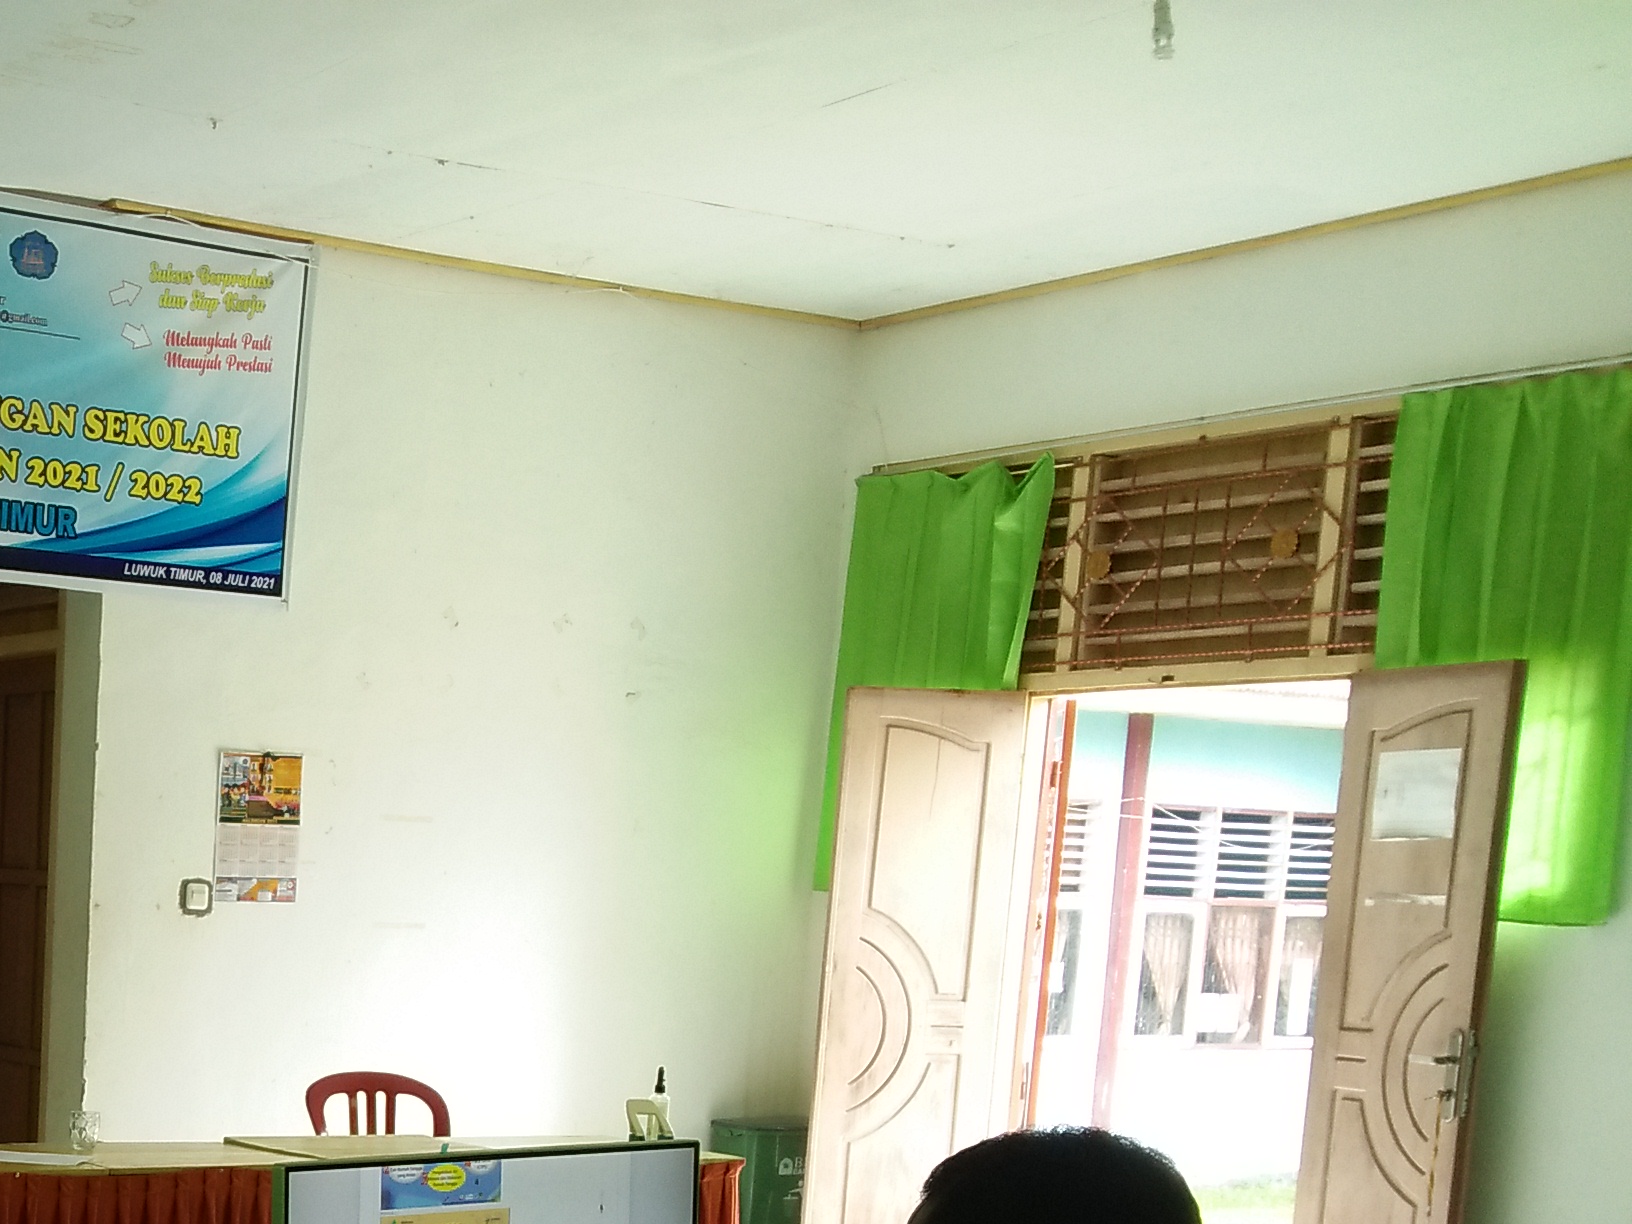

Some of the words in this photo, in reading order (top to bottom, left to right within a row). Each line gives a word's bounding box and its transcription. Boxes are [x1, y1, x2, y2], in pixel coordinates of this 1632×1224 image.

[163, 329, 237, 354] Melangkah
[241, 332, 273, 351] Pasti
[226, 354, 273, 373] Prestasi
[82, 411, 243, 460] SEKOLAH
[25, 457, 101, 493] 2021
[104, 462, 125, 502] /
[128, 469, 204, 507] 2022
[123, 562, 167, 579] LUWUK
[169, 567, 206, 585] TIMUR,
[209, 571, 222, 584] 08
[224, 574, 249, 587] JULI
[250, 576, 275, 589] 2021
